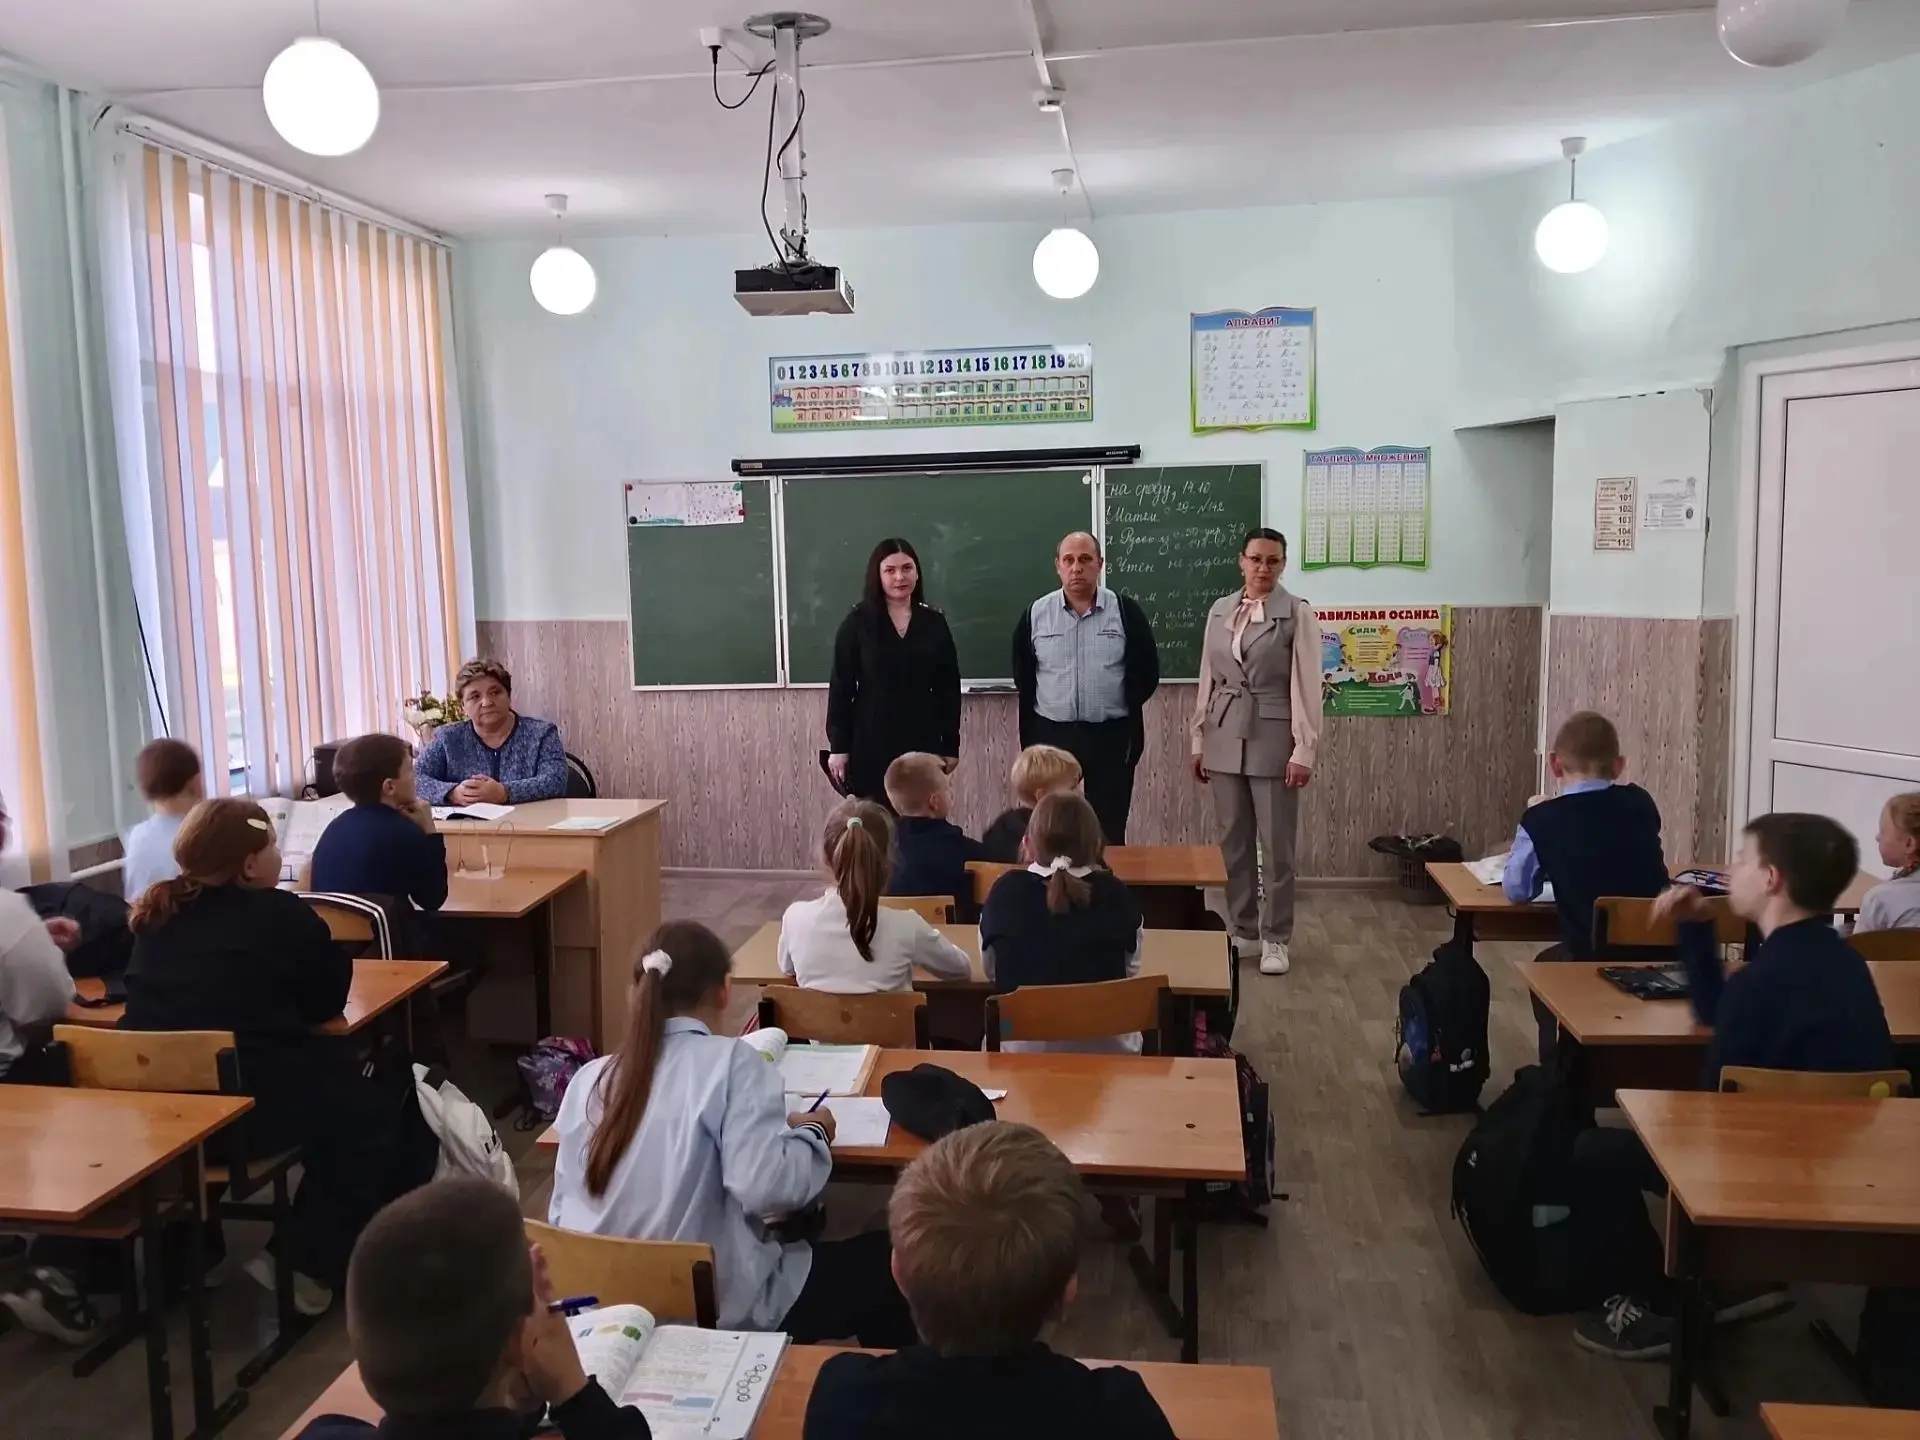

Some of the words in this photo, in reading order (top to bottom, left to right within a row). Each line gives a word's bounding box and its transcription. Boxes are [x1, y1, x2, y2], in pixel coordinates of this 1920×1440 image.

[1226, 317, 1281, 328] АЛФАВИТ
[777, 366, 786, 380] 0
[789, 365, 795, 380] 1
[799, 365, 807, 379] 2
[809, 364, 818, 379] 3
[820, 364, 828, 378] 4
[831, 363, 839, 378] 5
[841, 363, 849, 378] 6
[852, 363, 860, 377] 7
[862, 362, 870, 376] 8
[873, 362, 881, 376] 9
[885, 361, 900, 375] 10
[903, 360, 915, 375] 11
[920, 359, 934, 374] 12
[938, 359, 953, 373] 13
[956, 358, 972, 373] 14
[975, 357, 990, 372] 15
[994, 356, 1009, 371] 16
[1012, 356, 1027, 370] 17
[1031, 355, 1046, 369] 18
[1050, 354, 1065, 369] 19
[1068, 353, 1084, 368] 20
[1310, 454, 1358, 463] ТАБЛИЦА
[1359, 453, 1425, 462] УМНОЖЕНИЯ
[1110, 483, 1130, 497] на
[1620, 493, 1632, 501] 101
[1619, 505, 1632, 513] 102
[1618, 516, 1631, 524] 103
[1618, 527, 1631, 535] 104
[1617, 539, 1630, 547] 112
[1389, 609, 1440, 620] ОСАНКА
[1349, 626, 1377, 635] Сиди
[1367, 671, 1402, 684] Ходи
